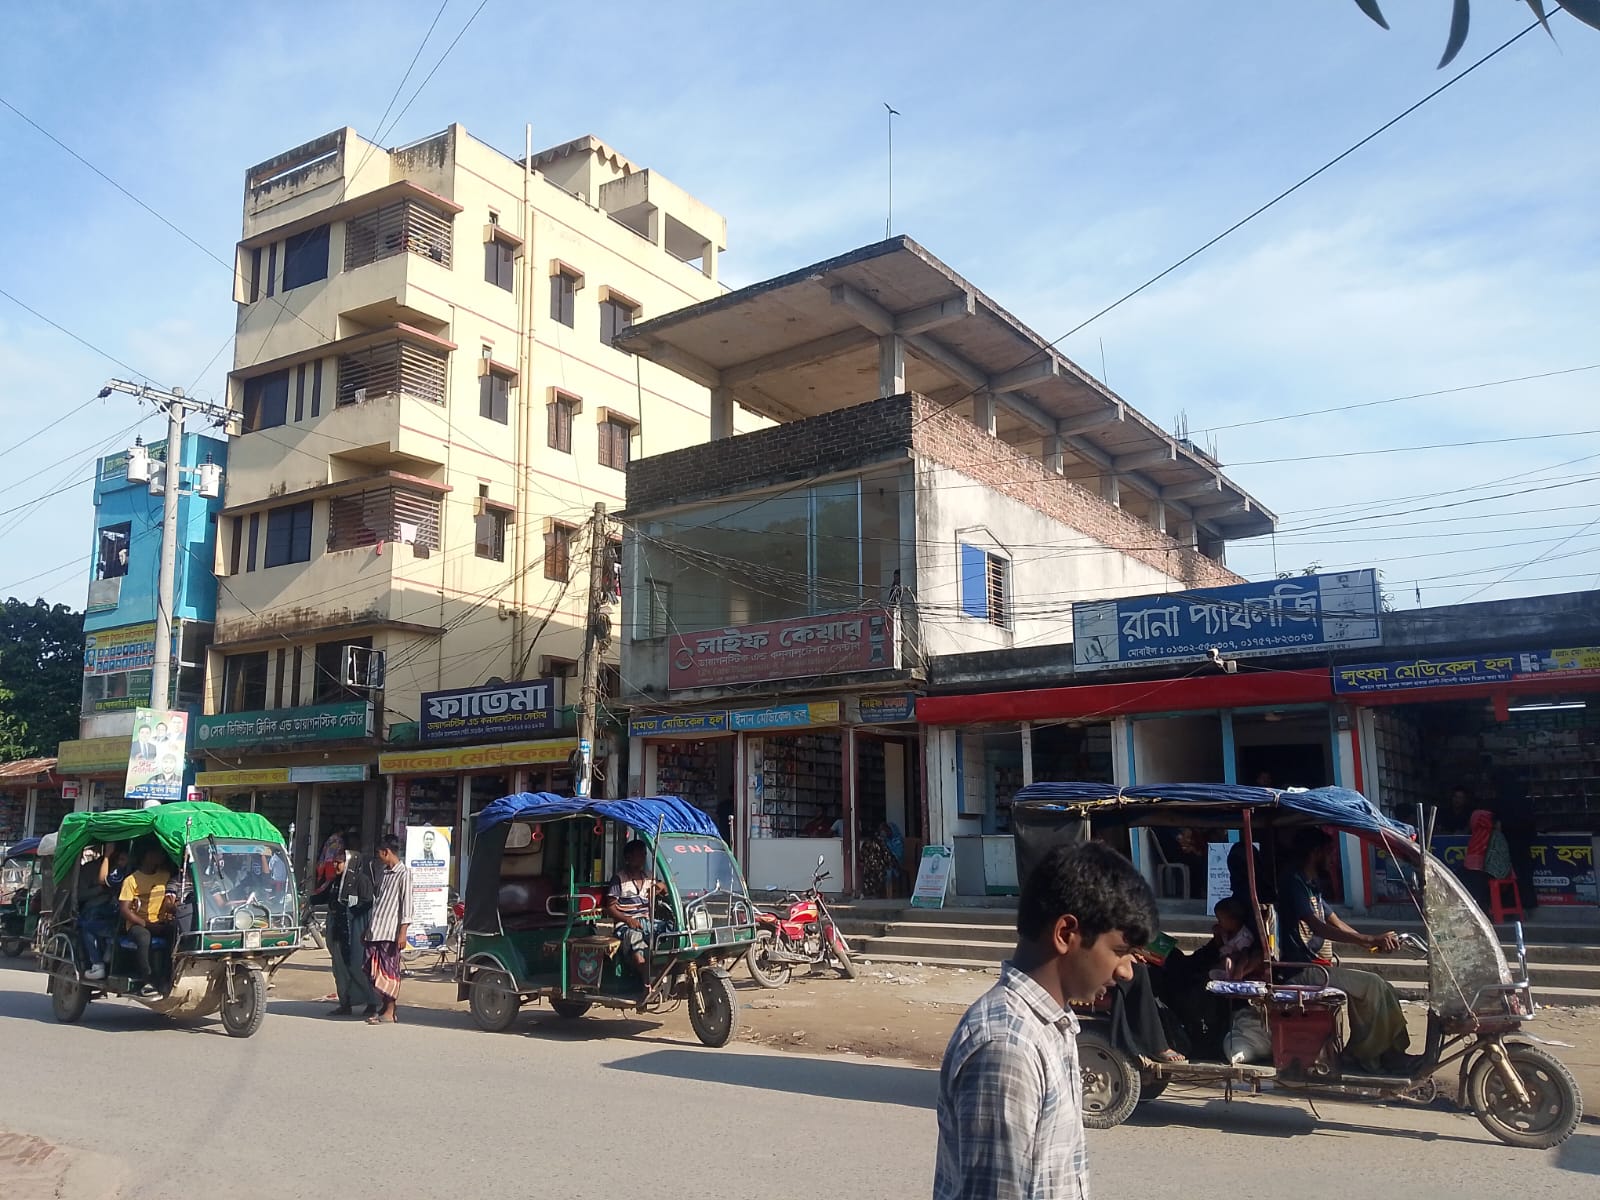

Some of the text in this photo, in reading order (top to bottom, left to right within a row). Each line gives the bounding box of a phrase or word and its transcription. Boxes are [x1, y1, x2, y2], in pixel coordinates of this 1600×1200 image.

[1119, 583, 1318, 643] রানা প্যাথলজি
[696, 618, 864, 655] লাইফ কেয়ার
[1127, 645, 1159, 657] মোবাইল
[1341, 667, 1389, 686] লুৎফা
[1395, 660, 1478, 679] মেডিকেল
[1482, 657, 1514, 672] হল
[427, 685, 548, 719] ফাতেমা
[210, 725, 225, 738] সেবা
[661, 715, 705, 730] মেডিকেল
[382, 755, 453, 769] আলেয়া
[459, 748, 558, 766] মেডিকেল
[1552, 845, 1593, 866] হল
